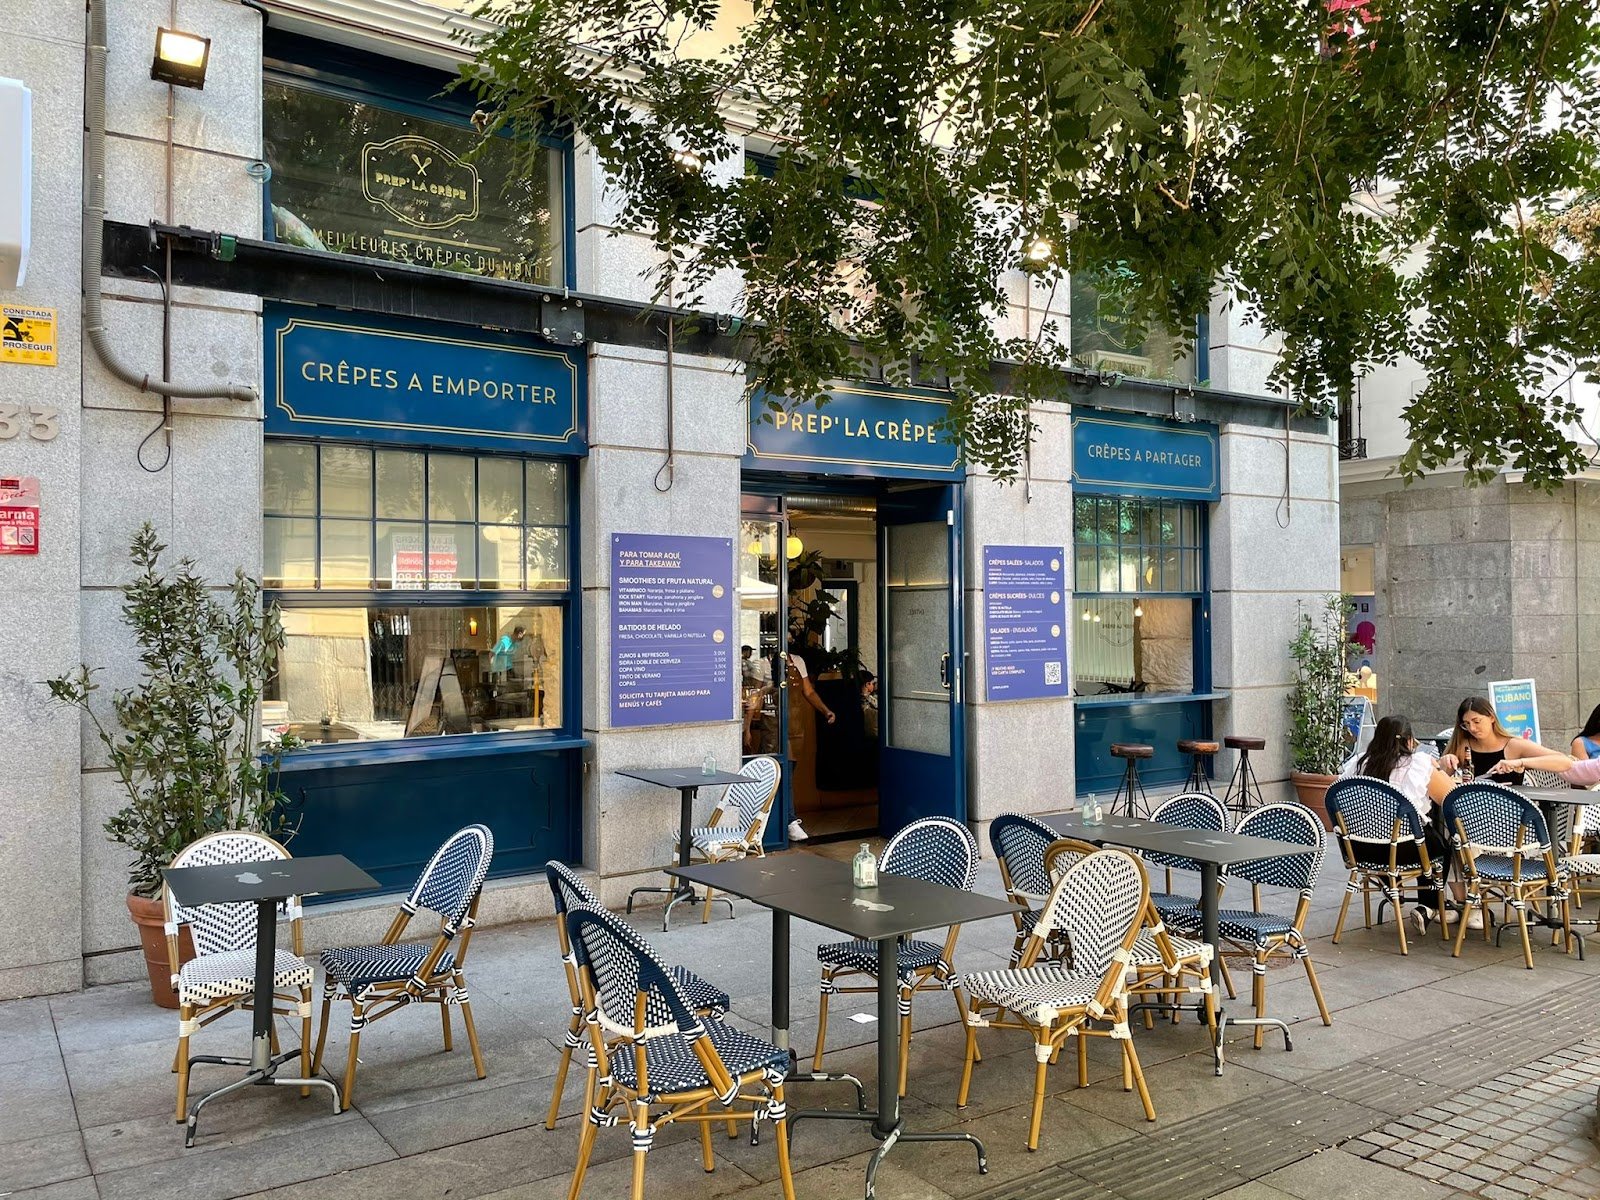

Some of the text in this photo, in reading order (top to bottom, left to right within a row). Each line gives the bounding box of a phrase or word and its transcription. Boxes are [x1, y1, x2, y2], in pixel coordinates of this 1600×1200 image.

[412, 180, 428, 192] LA
[430, 184, 467, 200] CRÊPE
[313, 229, 408, 258] MEILLEURES
[416, 240, 472, 268] CRÊPES
[478, 257, 496, 272] DU
[502, 260, 551, 282] MONDE
[3, 308, 52, 318] CONECTADA
[3, 342, 53, 352] PROSEGUR
[301, 360, 557, 406] CRÊPES A EMPORTER
[774, 412, 938, 444] PREP' LA CRÊPE
[1088, 443, 1202, 468] CRÊPES A PARTAGER
[1496, 692, 1531, 703] CUBANO
